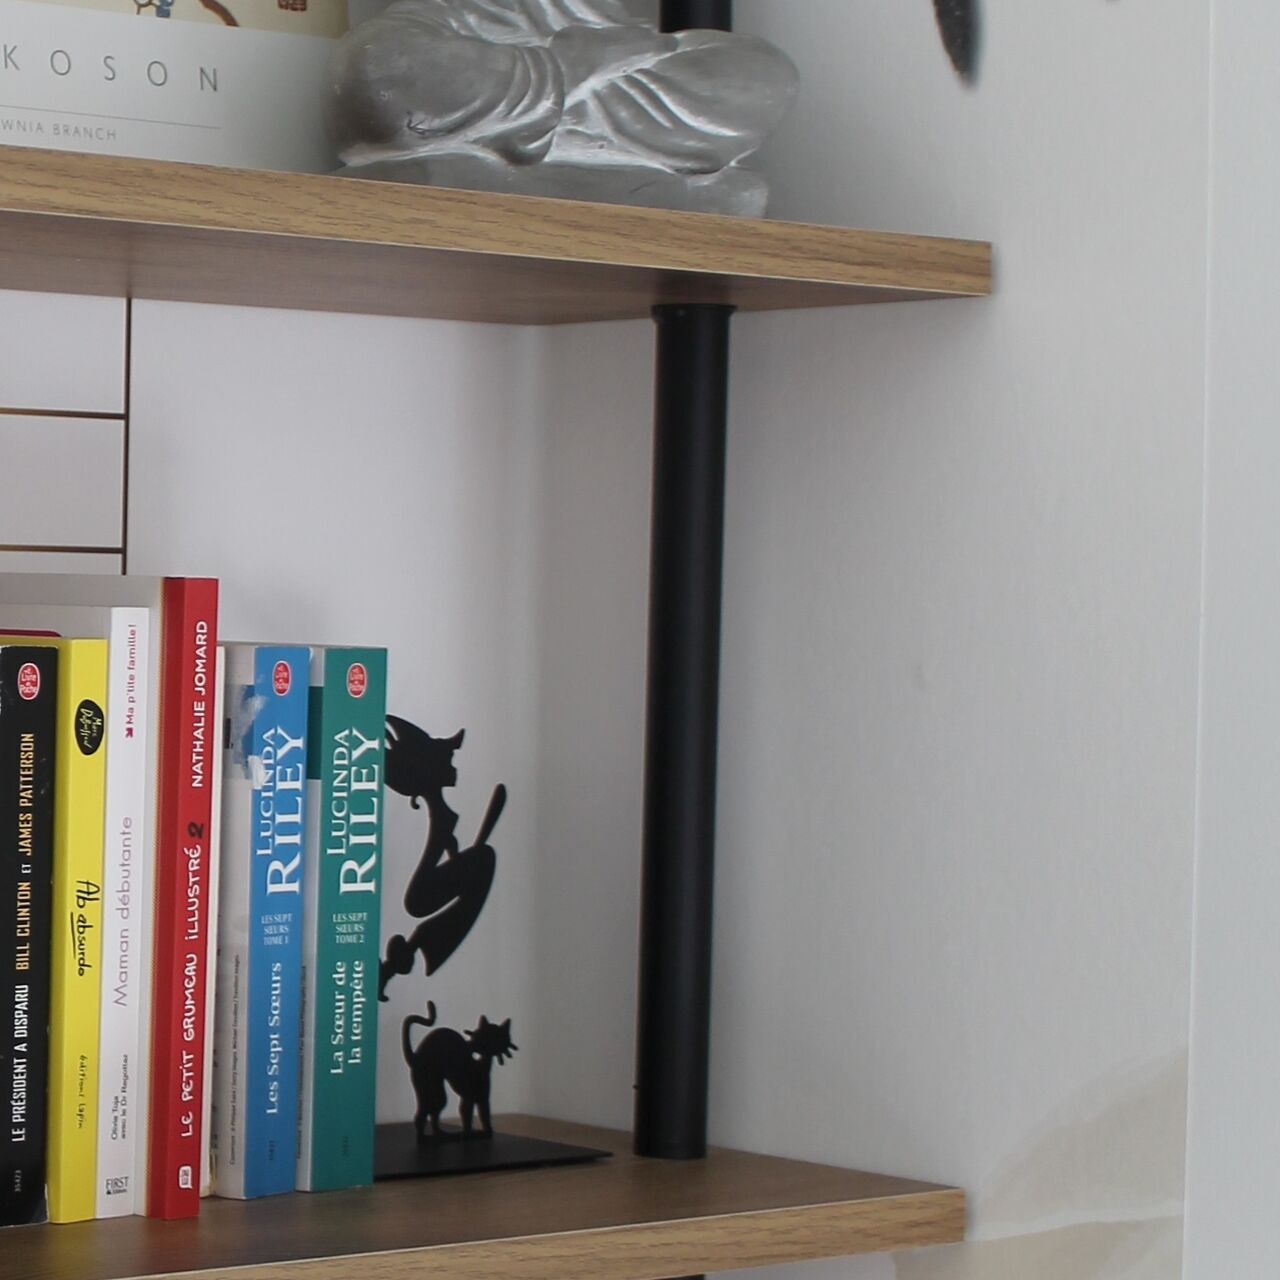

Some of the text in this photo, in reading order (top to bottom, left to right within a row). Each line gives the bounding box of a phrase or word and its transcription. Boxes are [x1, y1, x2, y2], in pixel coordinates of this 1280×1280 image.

[2, 44, 218, 92] KOSON
[53, 124, 116, 141] BRANCH
[126, 707, 135, 725] Ma
[192, 621, 208, 787] NATHALIE JOMARD
[188, 822, 205, 838] 2
[256, 727, 276, 856] LUCINDA
[266, 725, 303, 896] RILEY
[326, 728, 350, 856] LUCINDA
[339, 726, 380, 896] RILEY
[10, 733, 35, 1142] LE PRÉSIDENT A DISPARU BILL CLINTON ET JAMES PATTERSON
[76, 880, 101, 977] Ab absurdo
[113, 816, 132, 1007] Maman débutante
[264, 935, 283, 946] TOME
[333, 912, 368, 924] LES SEPT
[335, 933, 365, 945] TOME 2
[183, 953, 198, 1042] GRUMEAU
[266, 962, 283, 1114] Les Sept Sœurs
[330, 961, 346, 1074] La Sœur de
[348, 960, 366, 1064] la tempête
[181, 1111, 193, 1137] LE
[106, 1176, 130, 1189] FIRST
